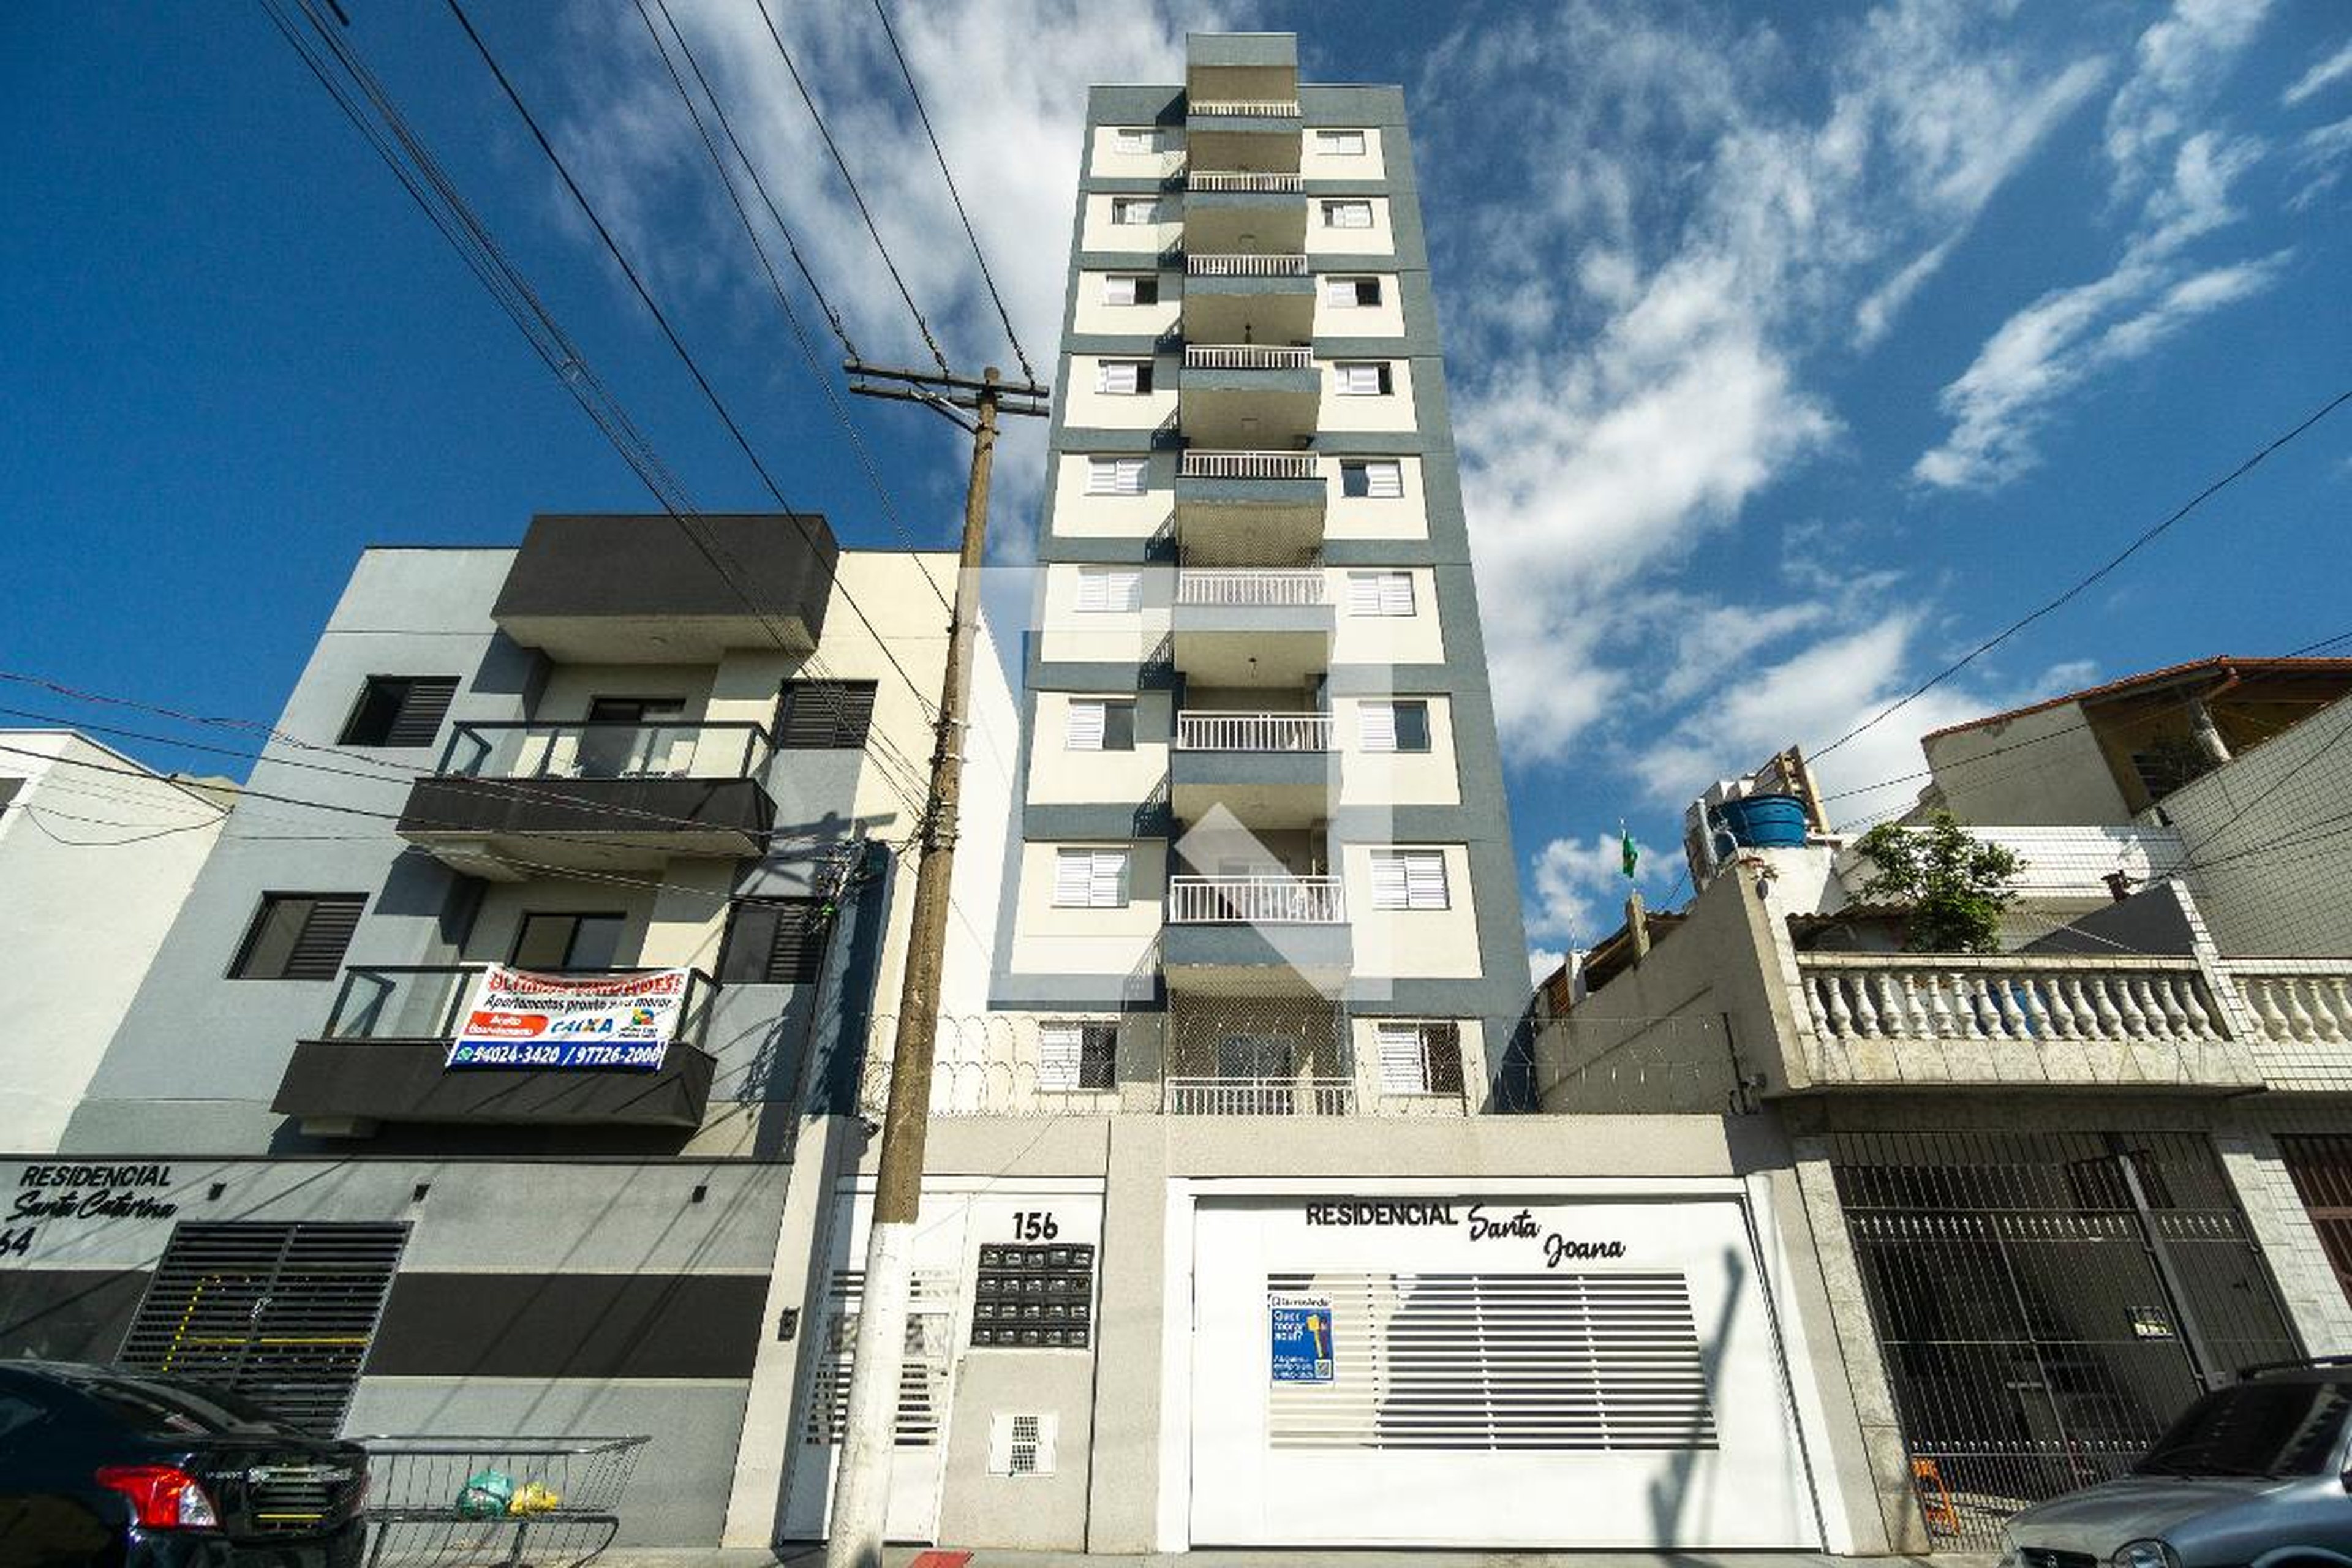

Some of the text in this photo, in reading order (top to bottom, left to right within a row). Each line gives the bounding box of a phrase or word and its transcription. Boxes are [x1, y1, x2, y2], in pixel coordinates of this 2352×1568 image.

[551, 1017, 613, 1033] CAIXA
[19, 1166, 170, 1187] RESIDENCIAL
[6, 1189, 178, 1222] Santa Catarina
[1012, 1212, 1058, 1240] 156
[1306, 1202, 1541, 1242] RESIDENCIAL Santa
[1543, 1232, 1626, 1268] Joana
